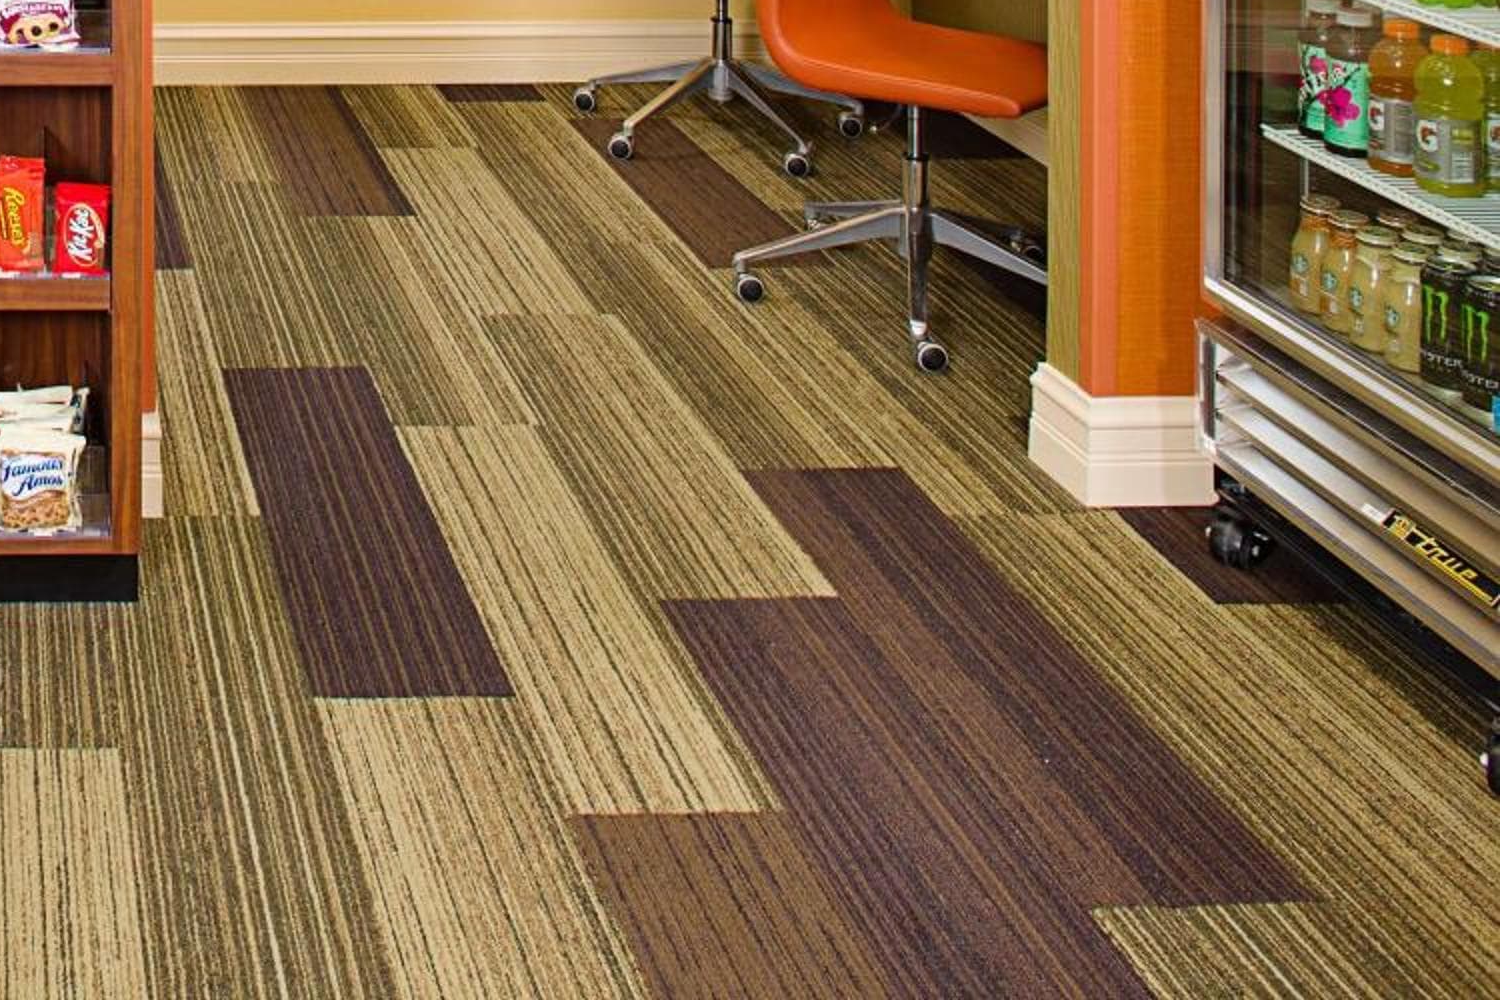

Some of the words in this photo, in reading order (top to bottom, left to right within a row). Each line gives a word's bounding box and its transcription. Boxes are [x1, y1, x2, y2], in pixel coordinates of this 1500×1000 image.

[3, 187, 27, 246] Reese's
[1, 459, 63, 481] Famous
[11, 475, 64, 498] Amos
